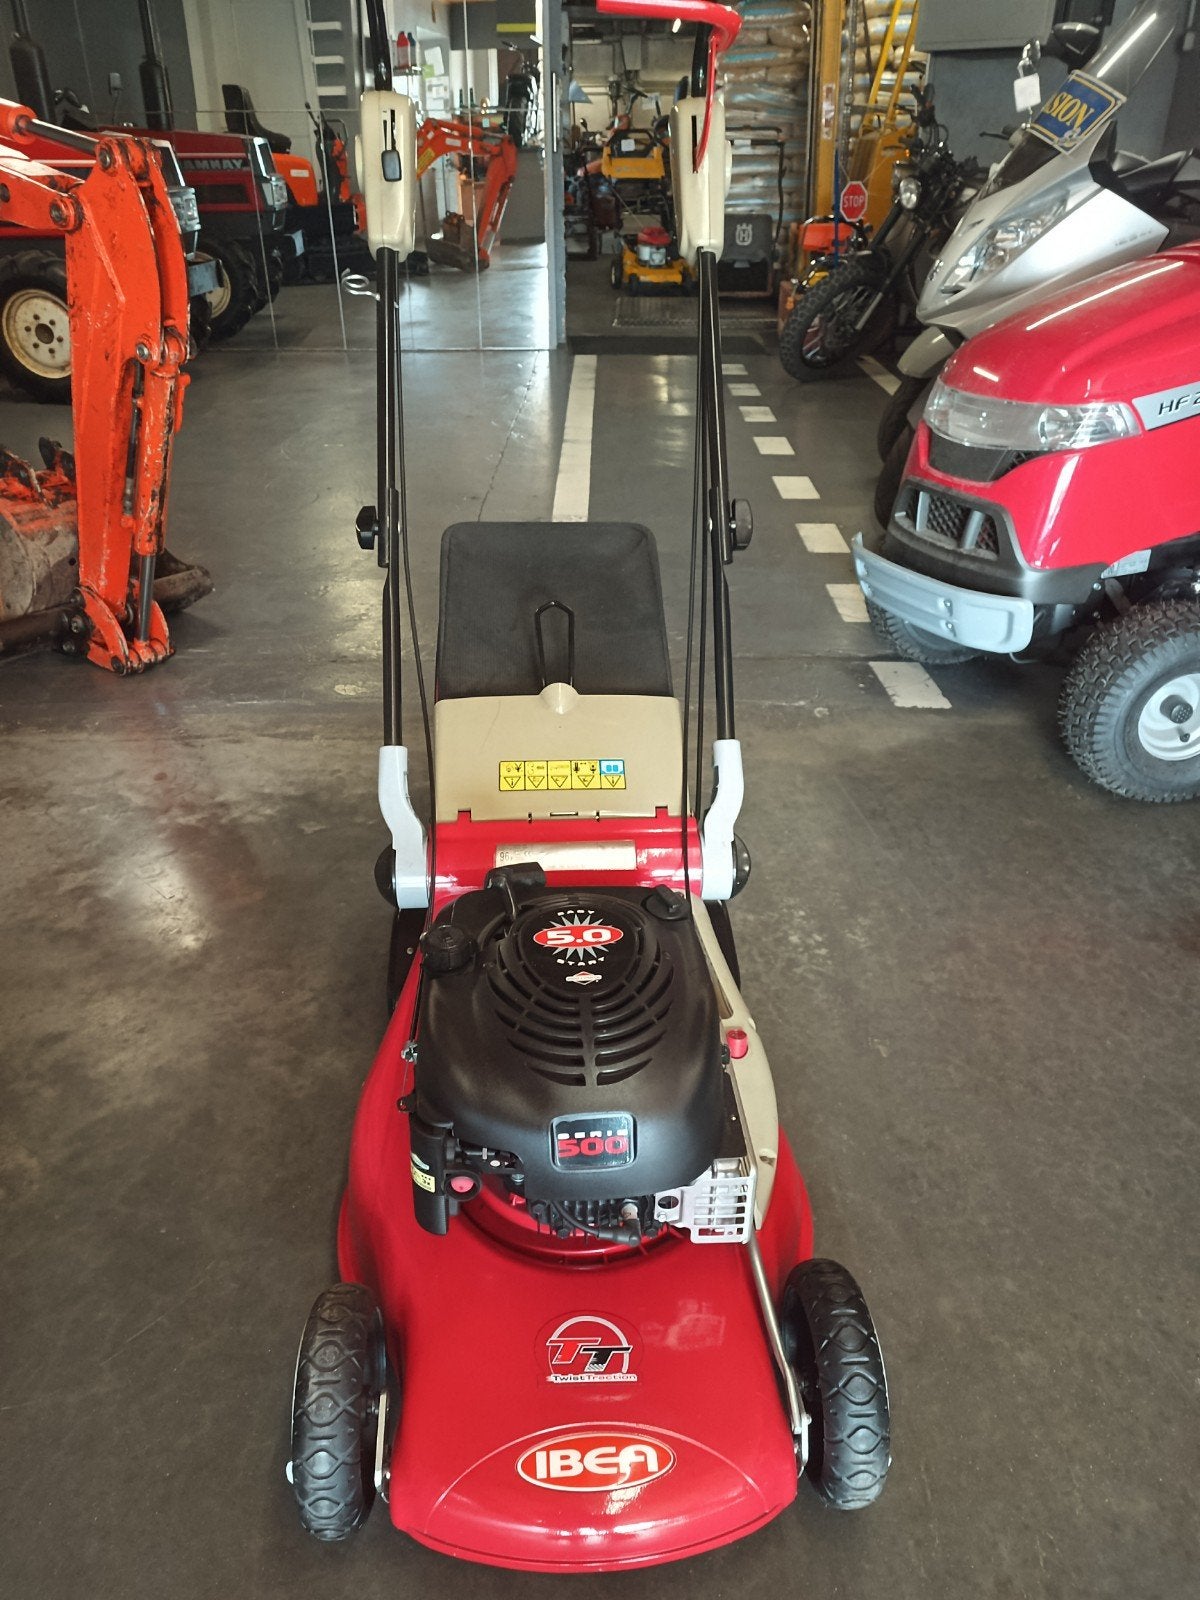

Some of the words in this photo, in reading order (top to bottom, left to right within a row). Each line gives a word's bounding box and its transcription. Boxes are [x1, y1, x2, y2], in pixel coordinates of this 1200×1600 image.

[1042, 91, 1095, 131] SION
[843, 195, 865, 208] STOP
[546, 928, 612, 945] 5.0
[557, 1135, 629, 1158] 500
[546, 1337, 633, 1372] TT
[535, 1444, 659, 1481] IBEA
